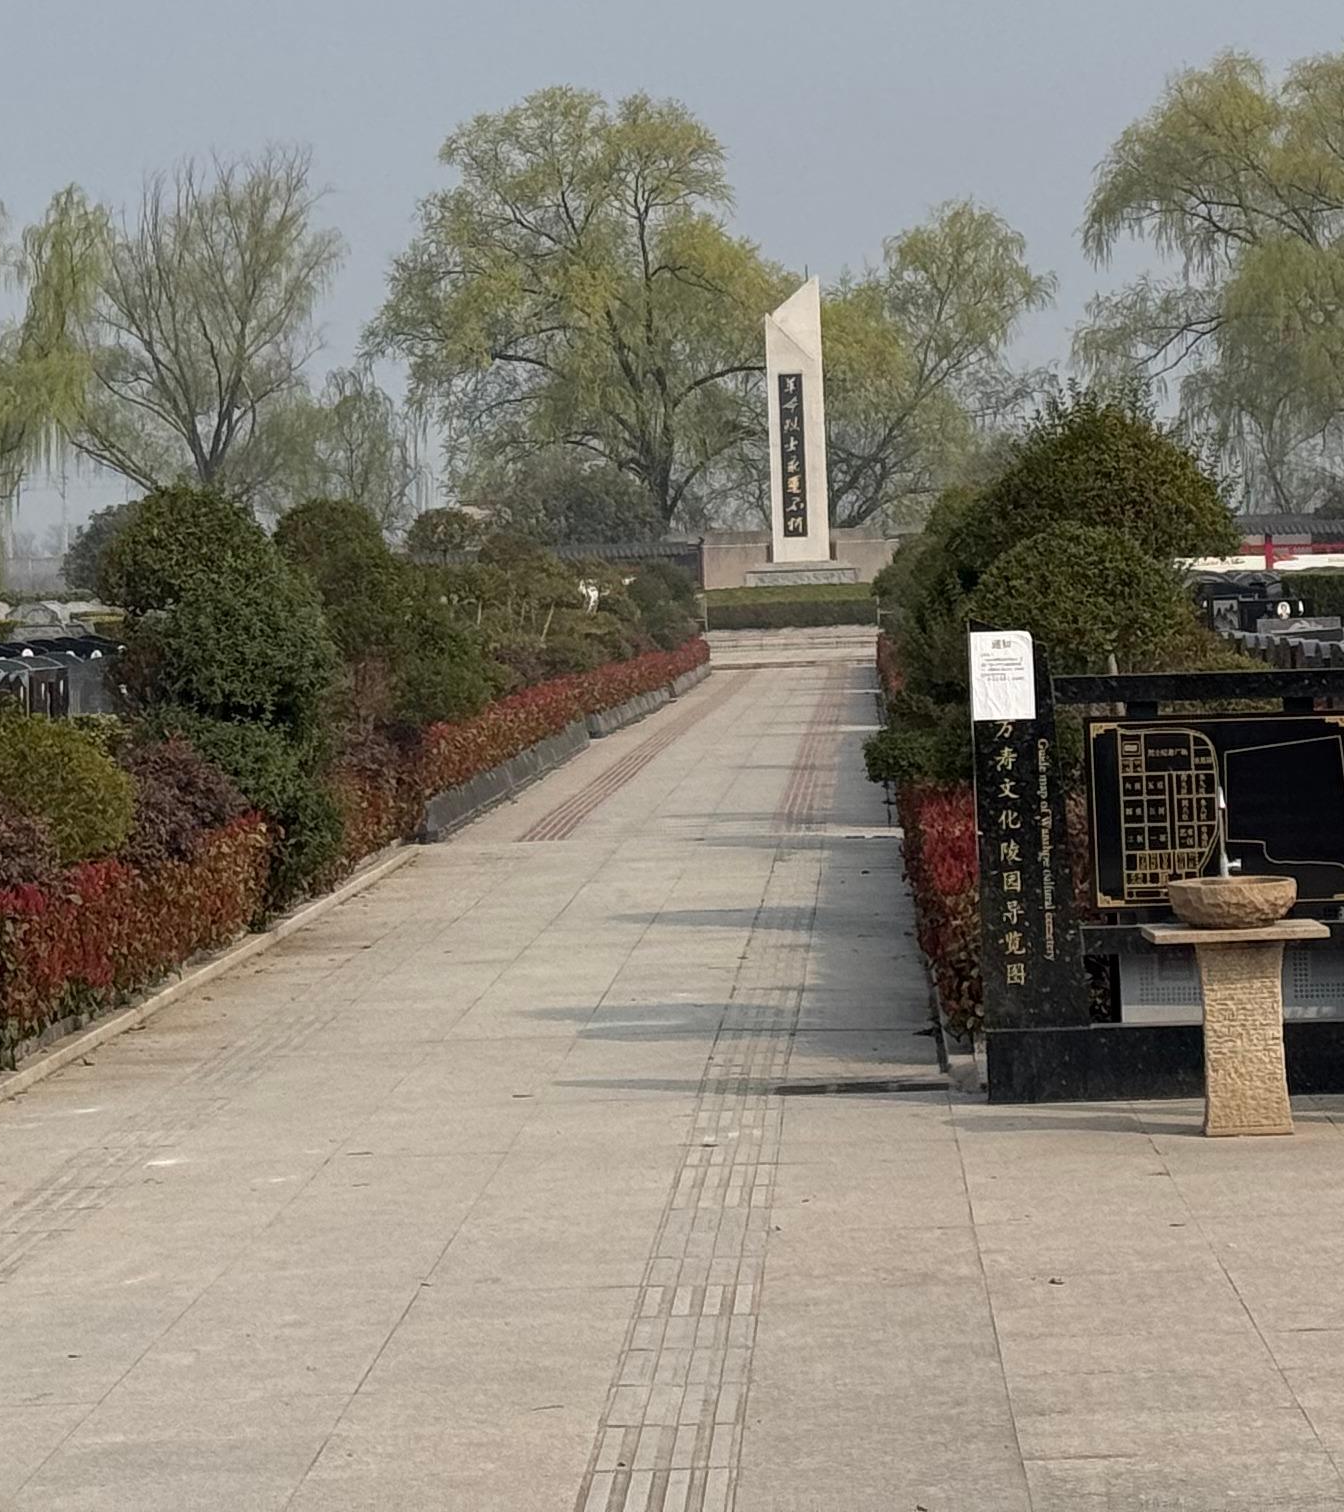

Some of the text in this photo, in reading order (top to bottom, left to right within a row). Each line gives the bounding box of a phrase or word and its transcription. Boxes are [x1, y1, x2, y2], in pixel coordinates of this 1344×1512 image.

[993, 719, 1027, 986] 万寿文化陵园导览图
